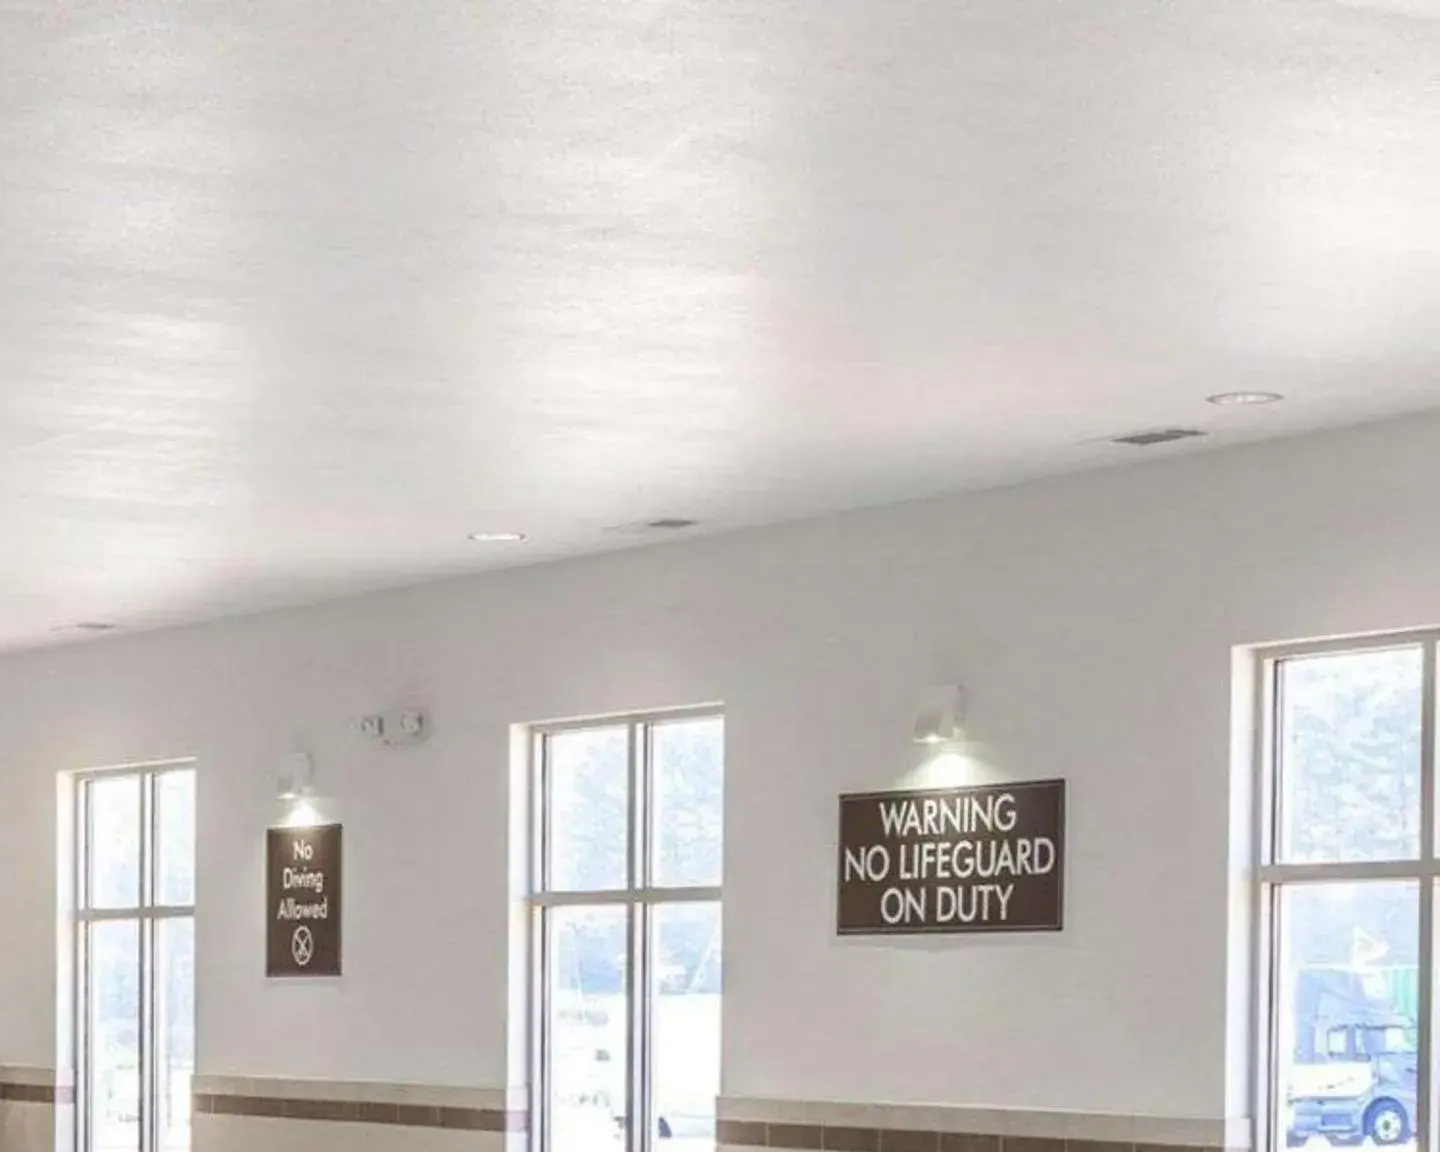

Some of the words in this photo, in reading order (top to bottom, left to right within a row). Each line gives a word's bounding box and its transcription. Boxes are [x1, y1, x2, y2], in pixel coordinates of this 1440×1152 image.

[879, 793, 1017, 837] WARNING
[292, 839, 314, 861] No
[844, 845, 890, 882] NO
[899, 837, 1056, 880] LIFEGUARD
[282, 867, 324, 893] Diving
[276, 897, 329, 920] Allowed
[880, 886, 927, 924] ON
[935, 883, 1015, 922] DUTY
